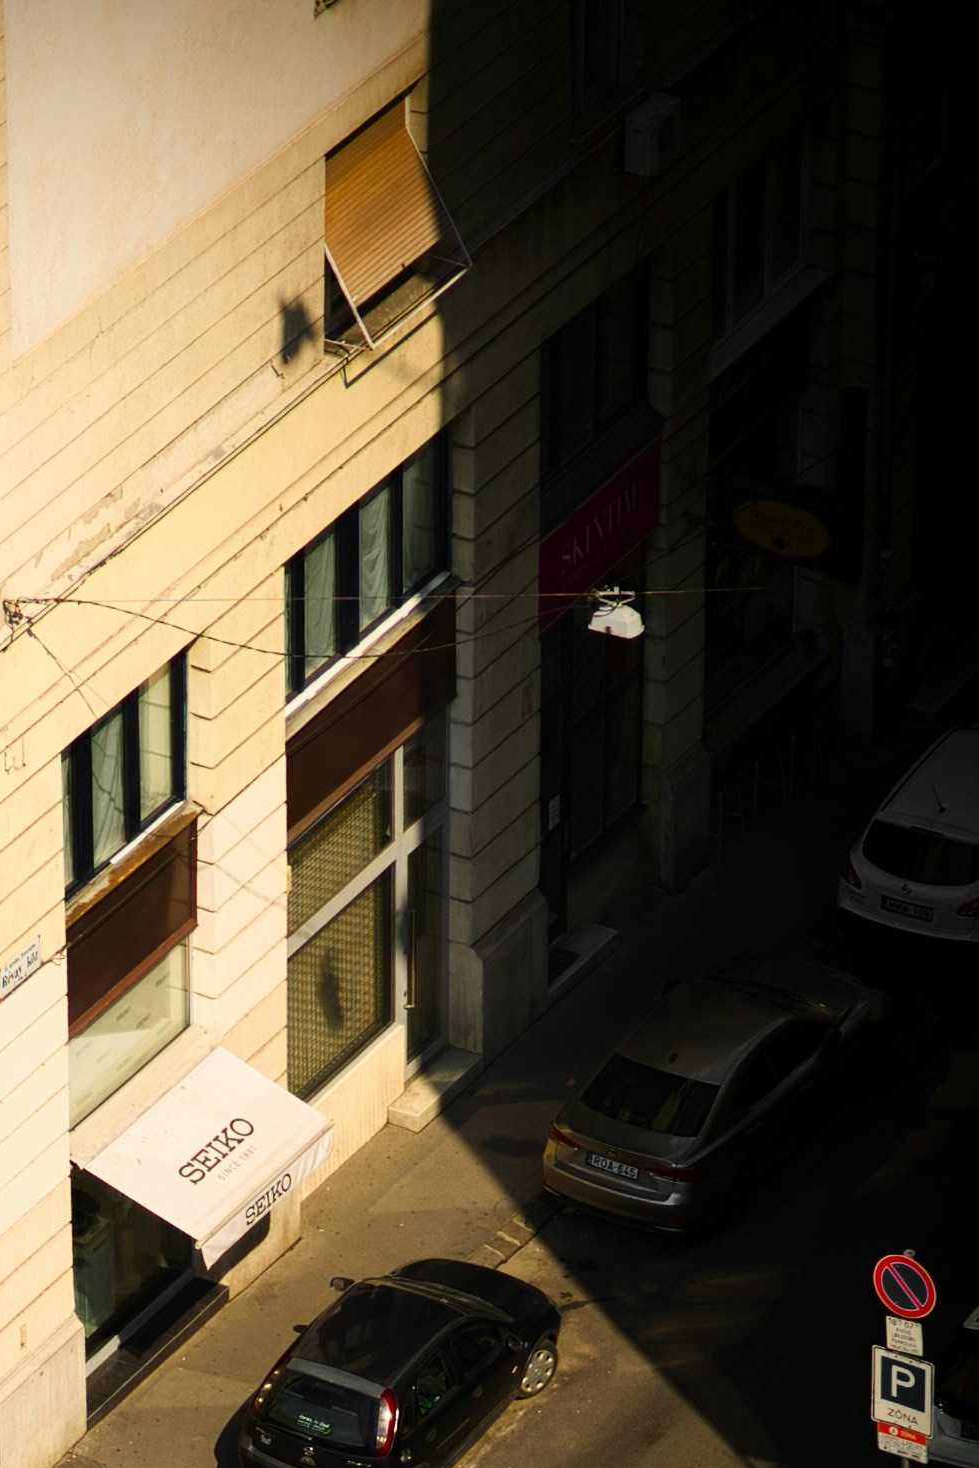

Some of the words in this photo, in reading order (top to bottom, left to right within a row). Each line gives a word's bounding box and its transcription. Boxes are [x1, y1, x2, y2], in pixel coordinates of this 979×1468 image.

[178, 1118, 255, 1186] SEIKO
[218, 1160, 241, 1181] SINCE
[593, 1156, 636, 1177] ROA-645
[245, 1173, 292, 1226] SEIKO
[891, 1364, 916, 1398] P
[887, 1407, 919, 1426] ZÓNA
